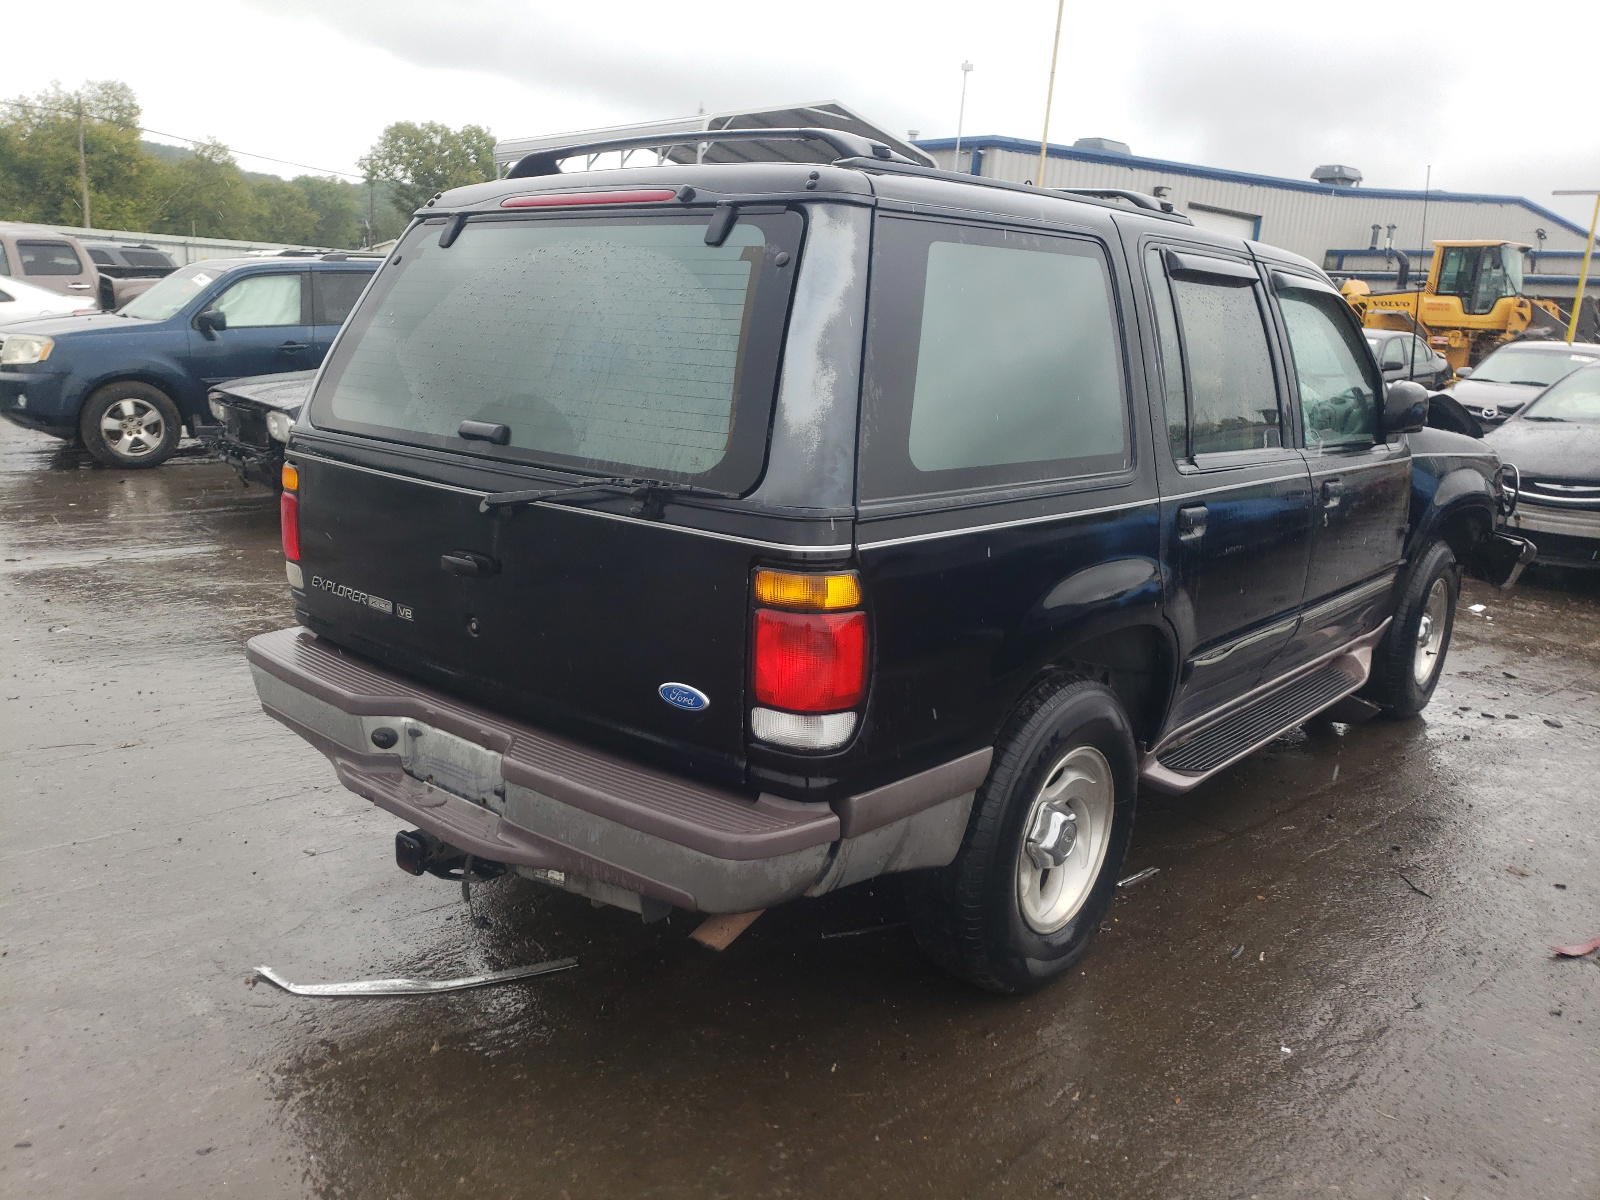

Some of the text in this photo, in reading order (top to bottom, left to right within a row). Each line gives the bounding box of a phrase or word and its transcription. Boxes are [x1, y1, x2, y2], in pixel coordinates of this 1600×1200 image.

[1372, 300, 1410, 308] VOLVO
[312, 575, 367, 605] EXPLORER
[398, 605, 413, 619] V8
[669, 687, 697, 706] Ford
